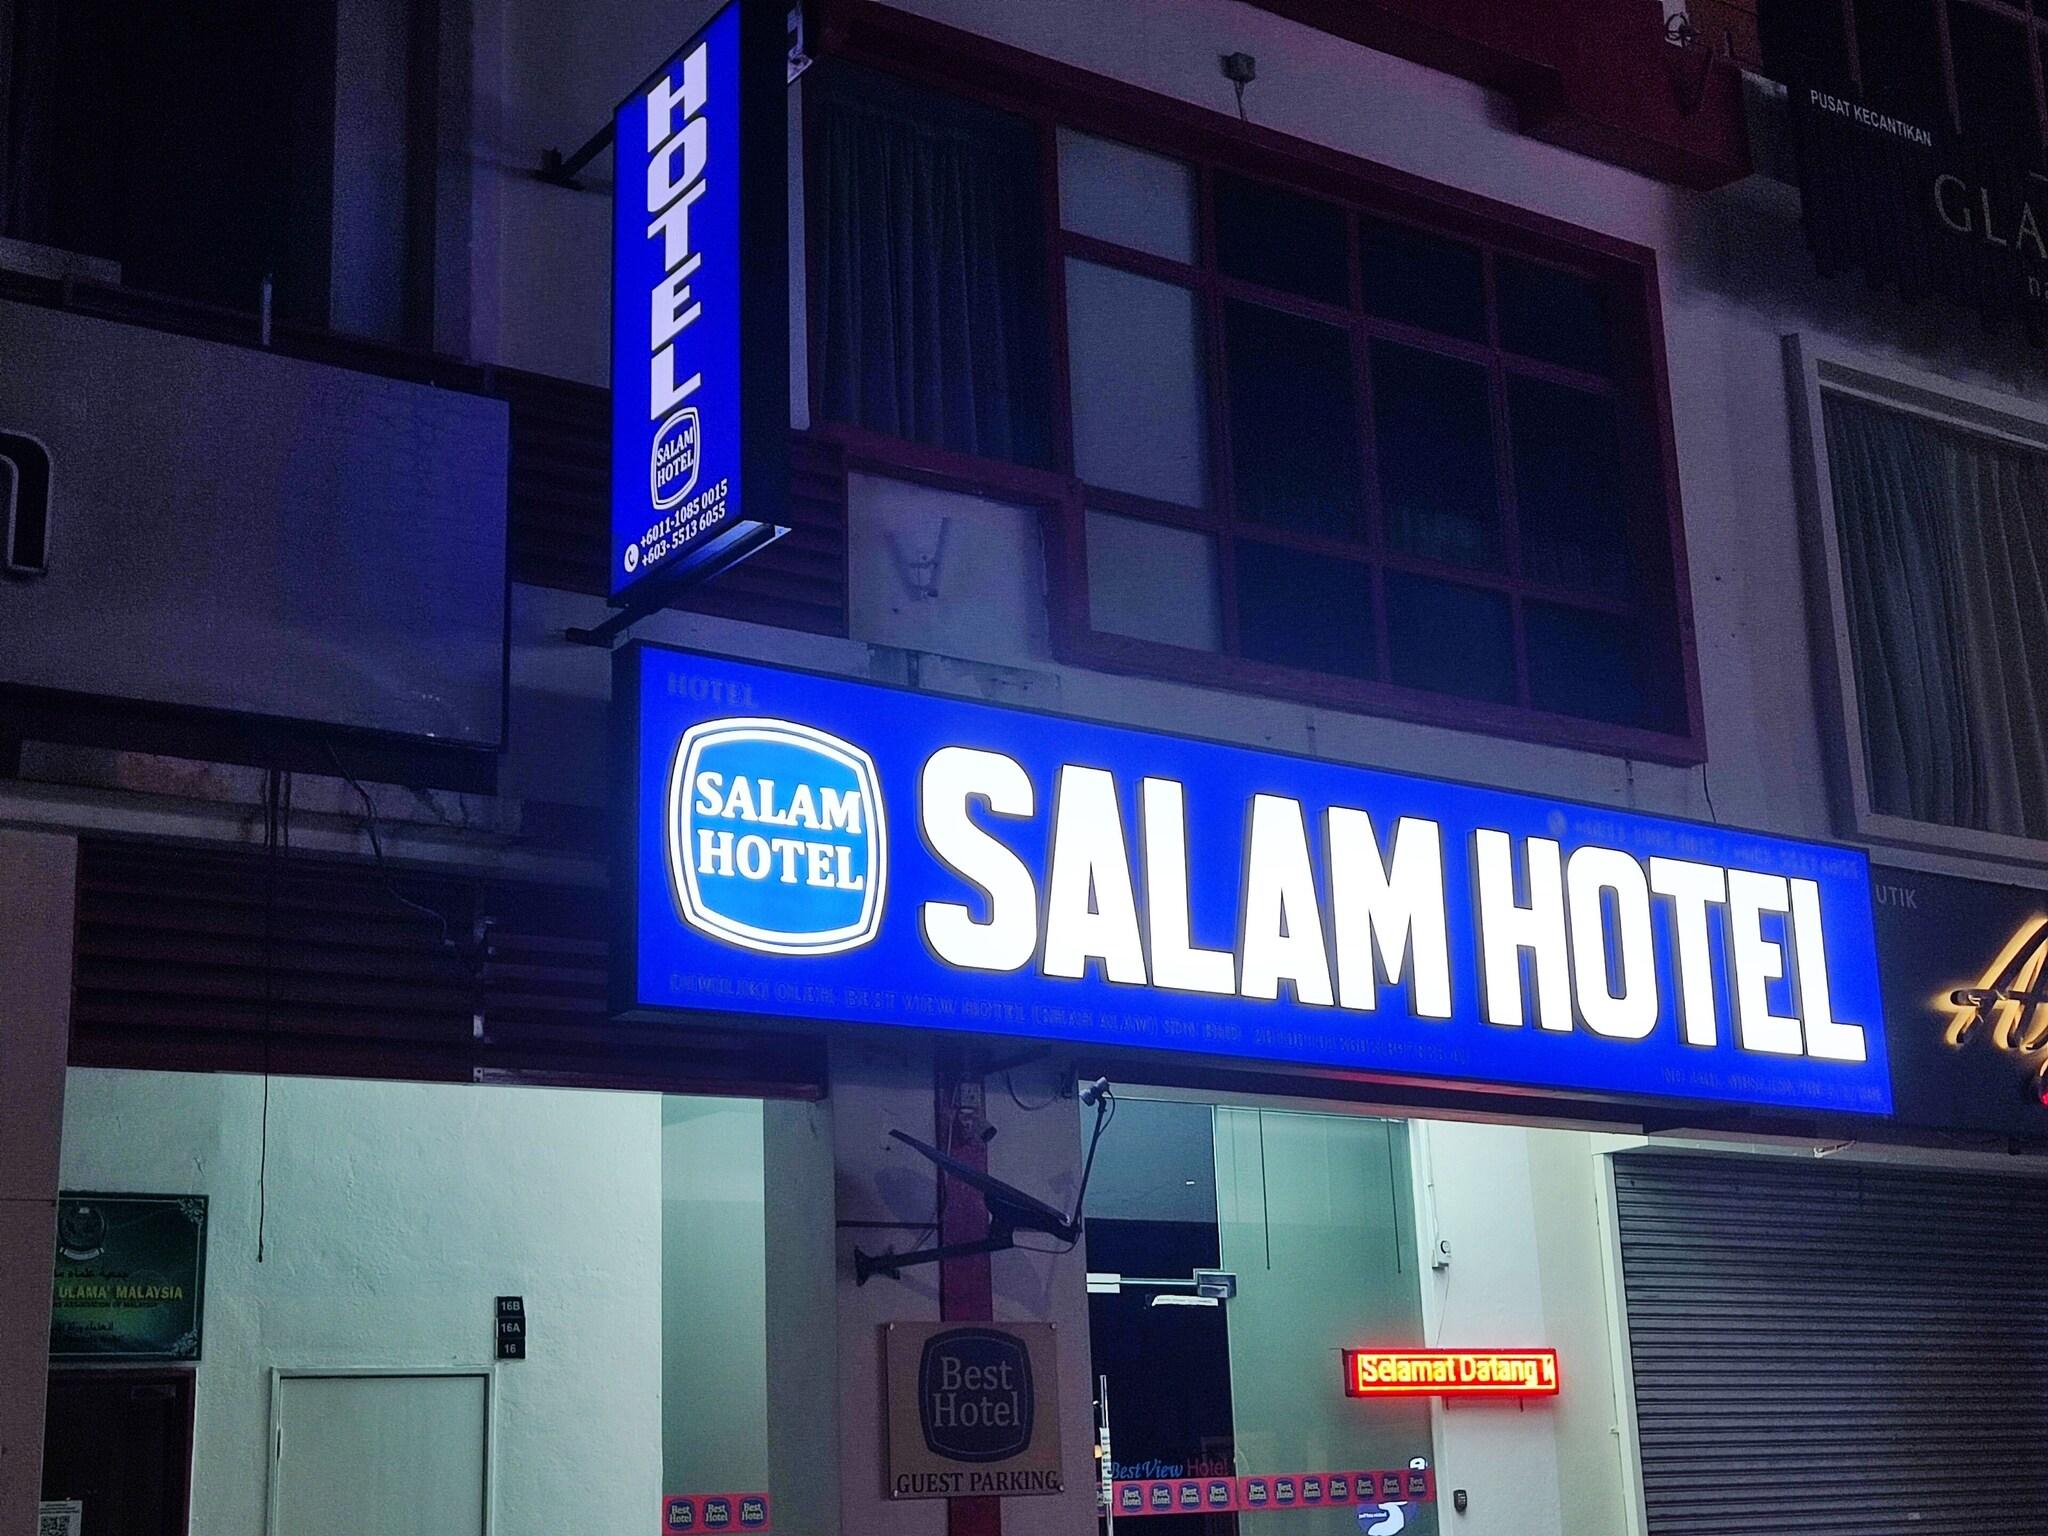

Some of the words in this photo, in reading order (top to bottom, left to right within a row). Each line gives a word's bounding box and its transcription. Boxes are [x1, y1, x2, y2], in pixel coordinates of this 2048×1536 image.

[1810, 90, 1851, 118] PUSAT
[1854, 105, 1932, 147] KECANTIKAN
[647, 42, 707, 420] HOTEL
[656, 426, 694, 467] SALAM
[657, 450, 694, 488] HOTEL
[640, 497, 700, 548] +6011-1085
[701, 478, 728, 510] 0015
[671, 519, 698, 549] 5513
[699, 501, 726, 532] 6055
[694, 771, 862, 834] SALAM
[696, 829, 864, 891] HOTEL
[921, 746, 1453, 1020] SALAM
[1472, 827, 1868, 1062] HOTEL
[1875, 884, 1917, 909] UTIK
[116, 1285, 183, 1300] MALAYSIA
[501, 1300, 521, 1311] 16B
[501, 1322, 521, 1333] 16A
[504, 1343, 517, 1354] 16
[941, 1356, 1013, 1390] Best
[1362, 1357, 1456, 1383] Selamat
[1459, 1357, 1539, 1387] Datang
[933, 1391, 1020, 1428] Hotel
[897, 1472, 964, 1494] GUEST
[970, 1470, 1058, 1492] PARKING
[672, 1505, 690, 1514] Best
[708, 1504, 725, 1512] Best
[743, 1503, 761, 1511] Best
